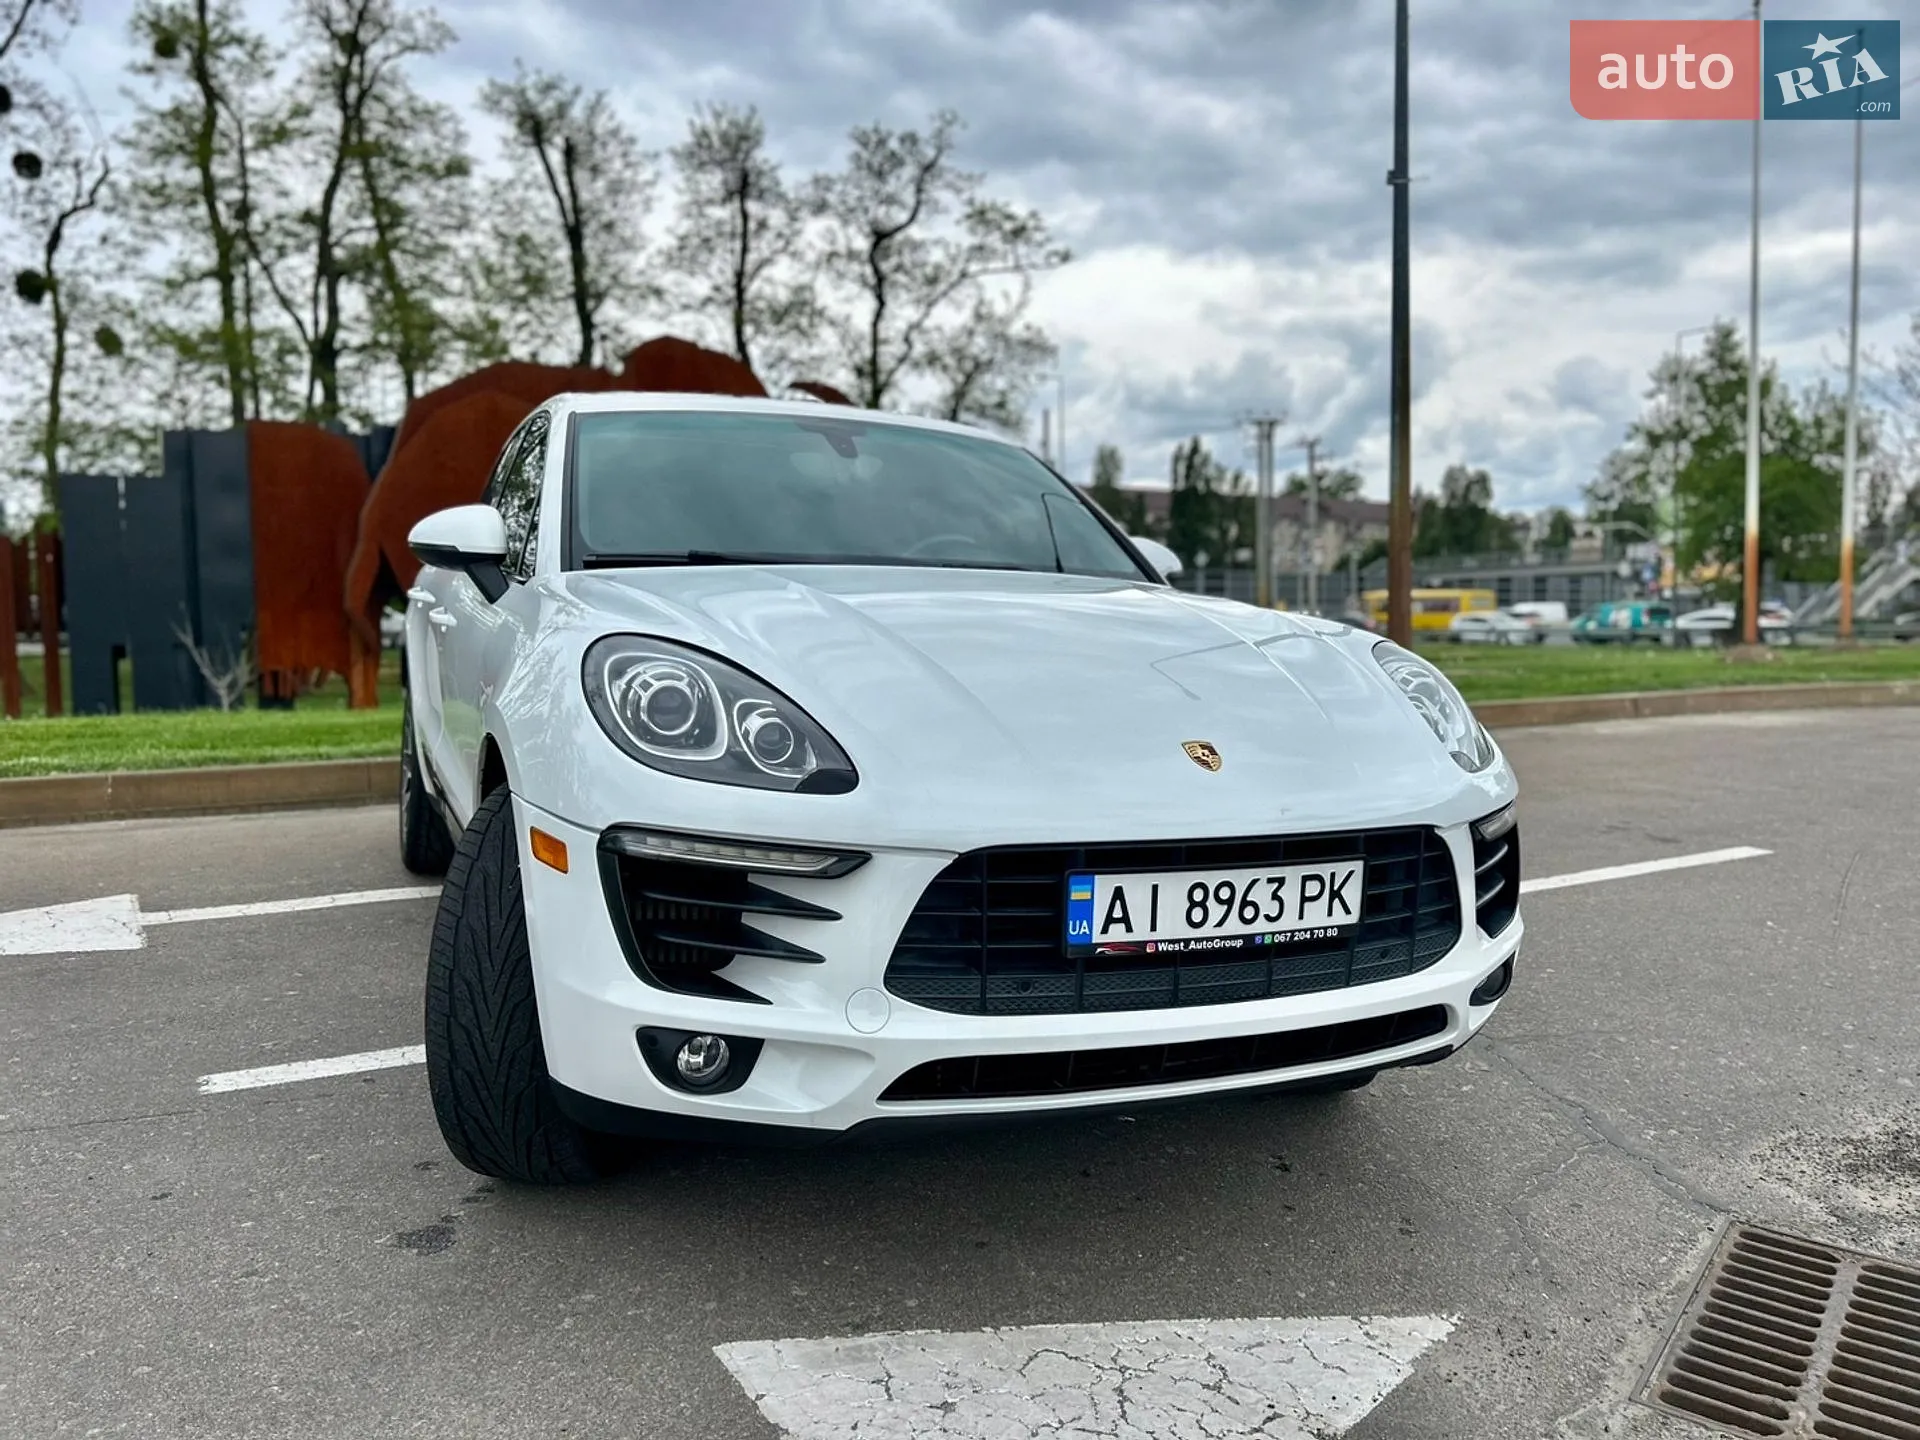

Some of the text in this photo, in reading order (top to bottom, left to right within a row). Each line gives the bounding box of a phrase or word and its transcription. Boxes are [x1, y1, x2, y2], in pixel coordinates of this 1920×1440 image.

[1100, 869, 1356, 935] AI 8963 PK
[1069, 919, 1090, 936] UA
[1273, 927, 1338, 943] 067 204 70 80
[1157, 938, 1244, 953] West_AutoGroup
